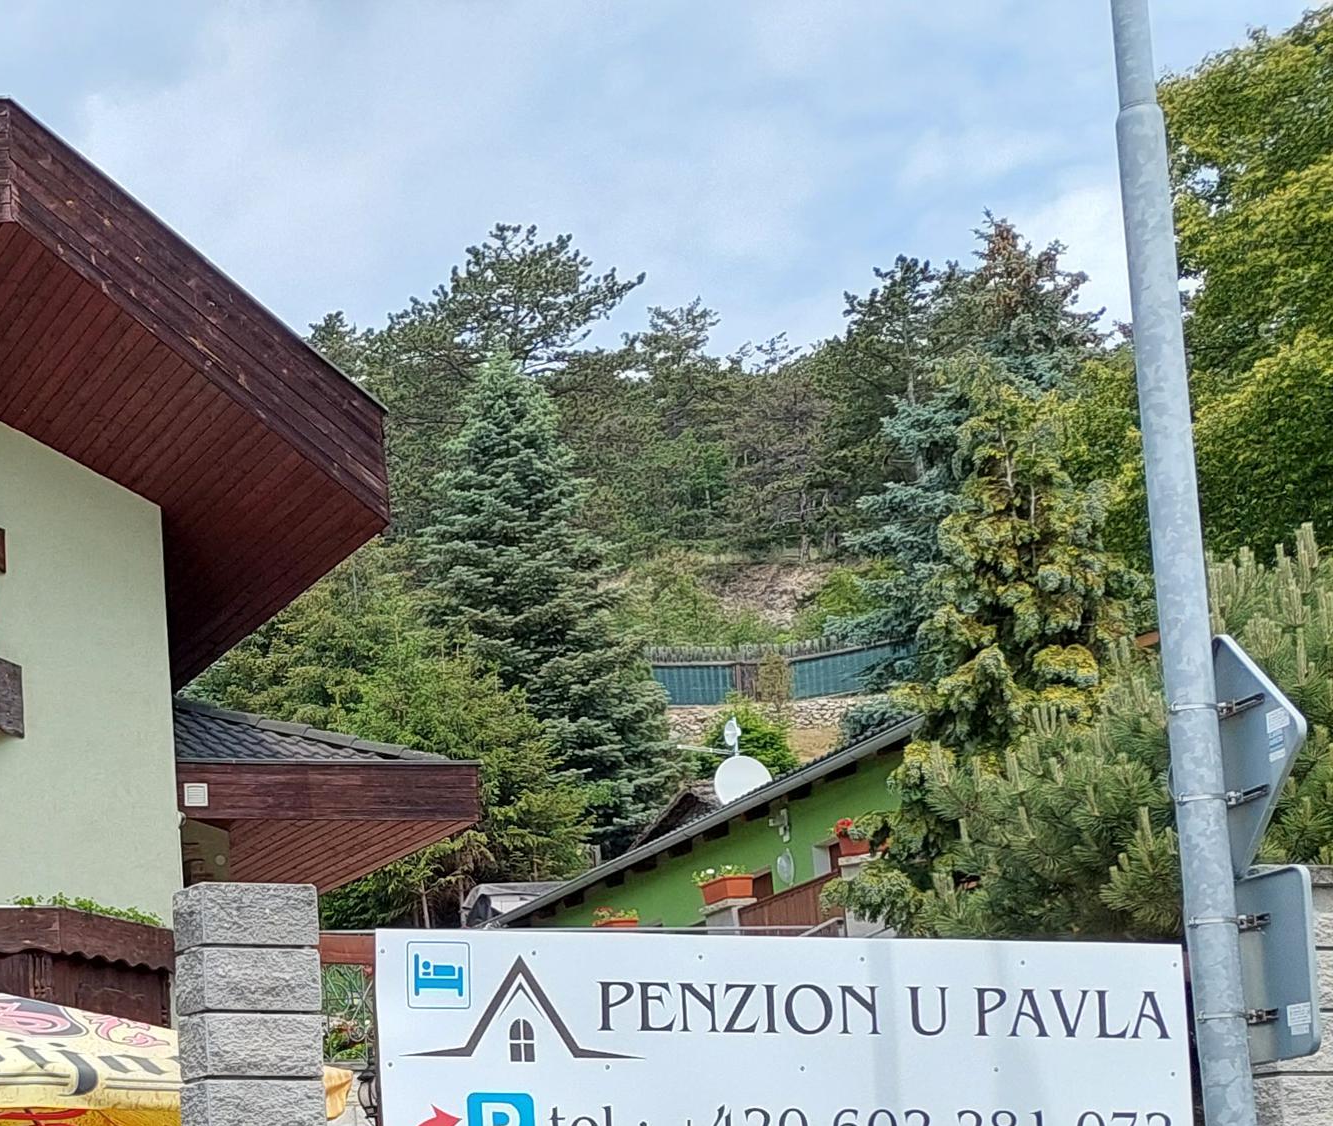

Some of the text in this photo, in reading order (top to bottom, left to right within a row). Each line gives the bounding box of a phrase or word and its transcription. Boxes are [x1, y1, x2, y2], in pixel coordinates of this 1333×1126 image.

[597, 980, 1172, 1042] PENZION U PAVLA
